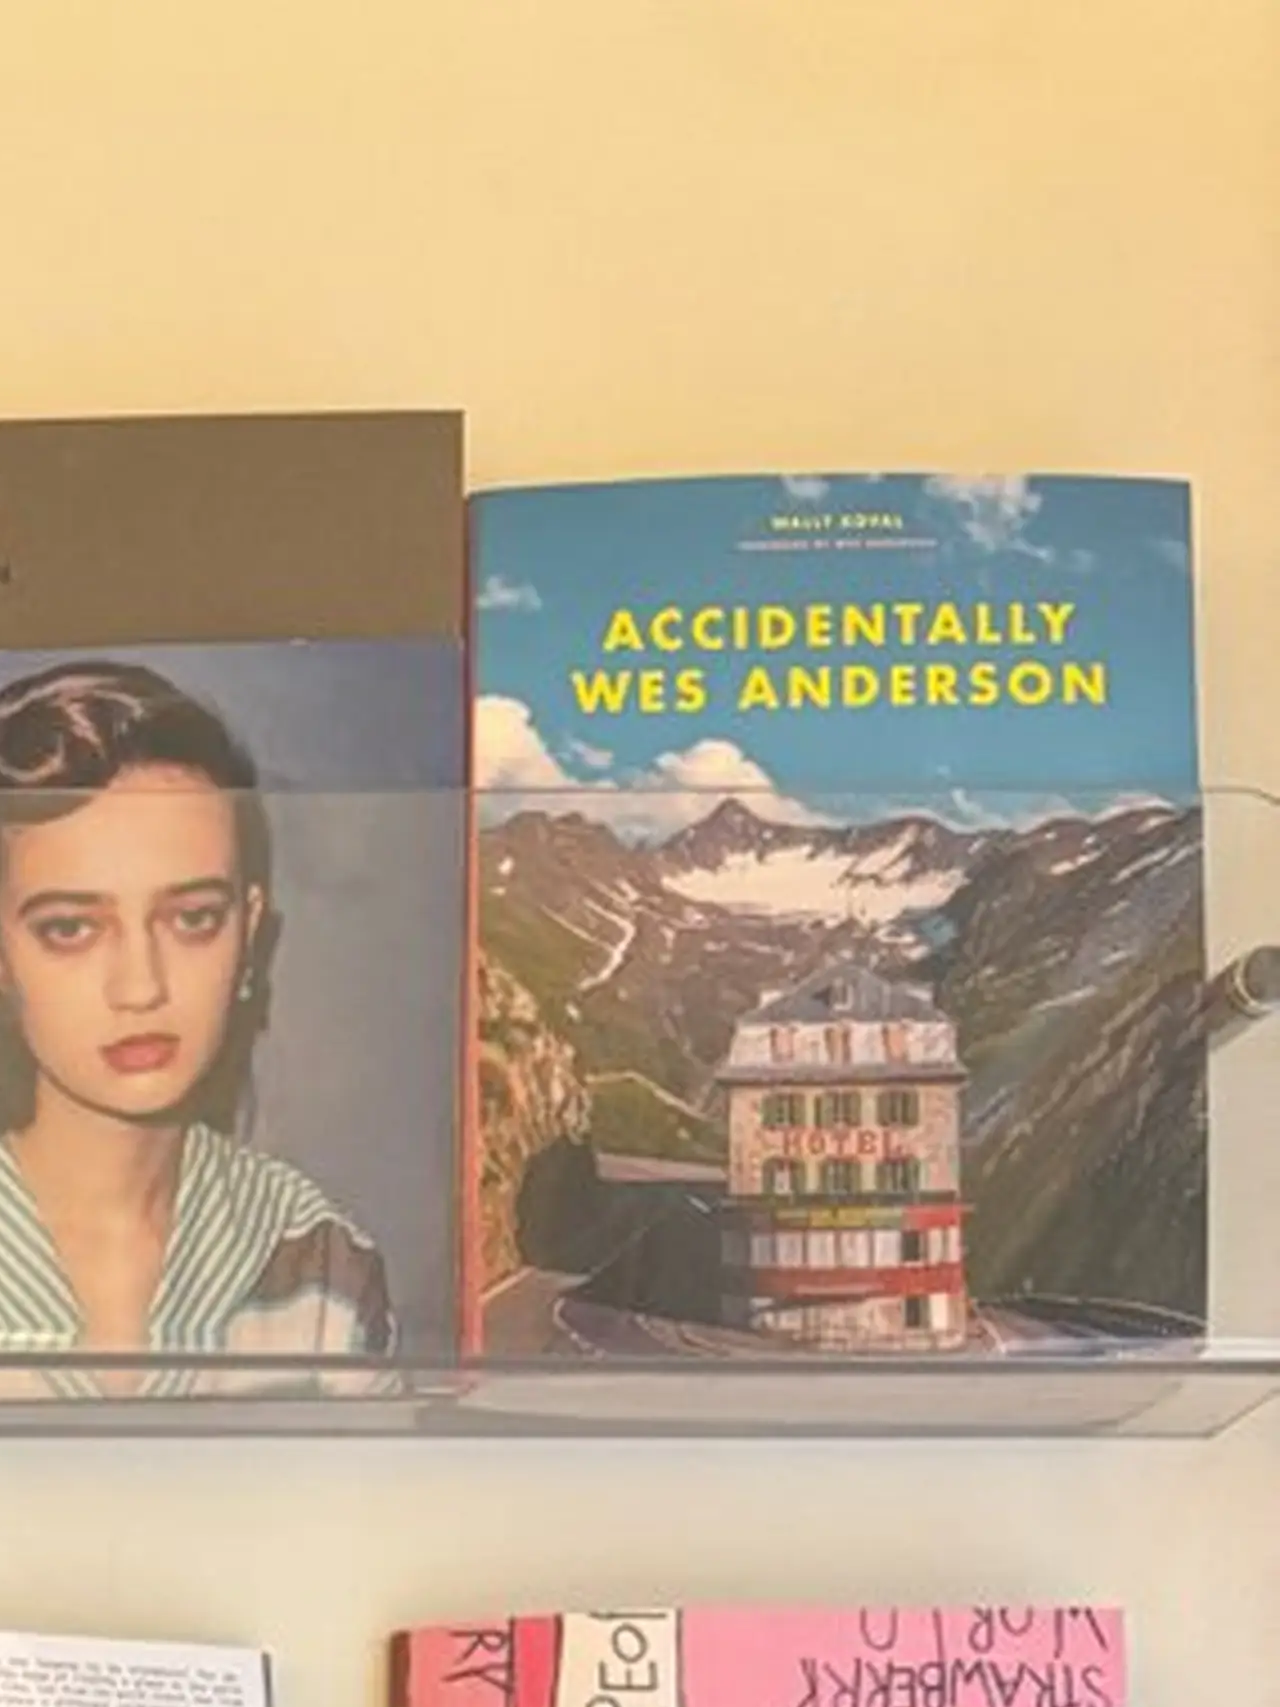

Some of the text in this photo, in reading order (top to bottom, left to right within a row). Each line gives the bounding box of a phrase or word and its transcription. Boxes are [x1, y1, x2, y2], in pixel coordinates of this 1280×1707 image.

[602, 602, 1076, 654] ACCIDENTALLY
[570, 661, 1108, 715] WES ANDERSON
